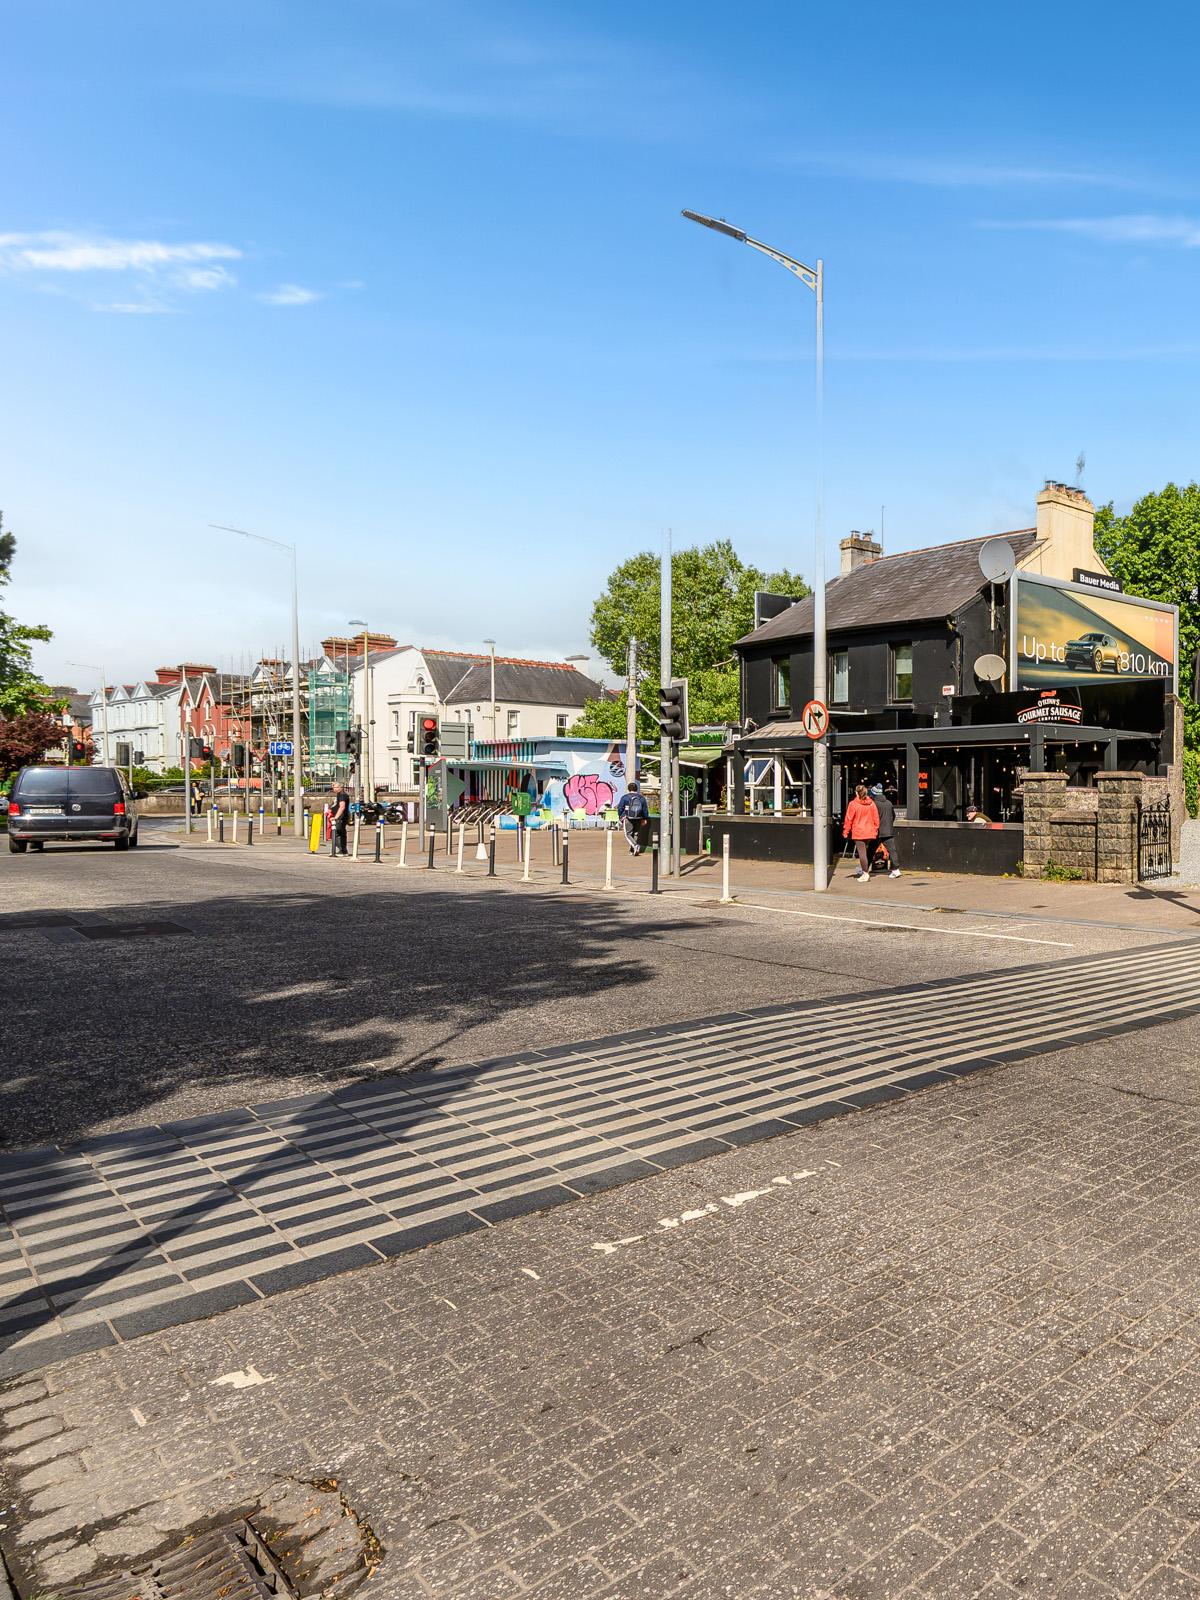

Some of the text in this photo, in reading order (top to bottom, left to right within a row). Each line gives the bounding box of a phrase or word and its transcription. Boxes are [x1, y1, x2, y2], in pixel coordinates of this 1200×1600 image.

[1079, 573, 1120, 591] Bauer Media
[1023, 635, 1169, 676] Up to 810 km
[1018, 707, 1082, 723] GOURMET SAUSAGE
